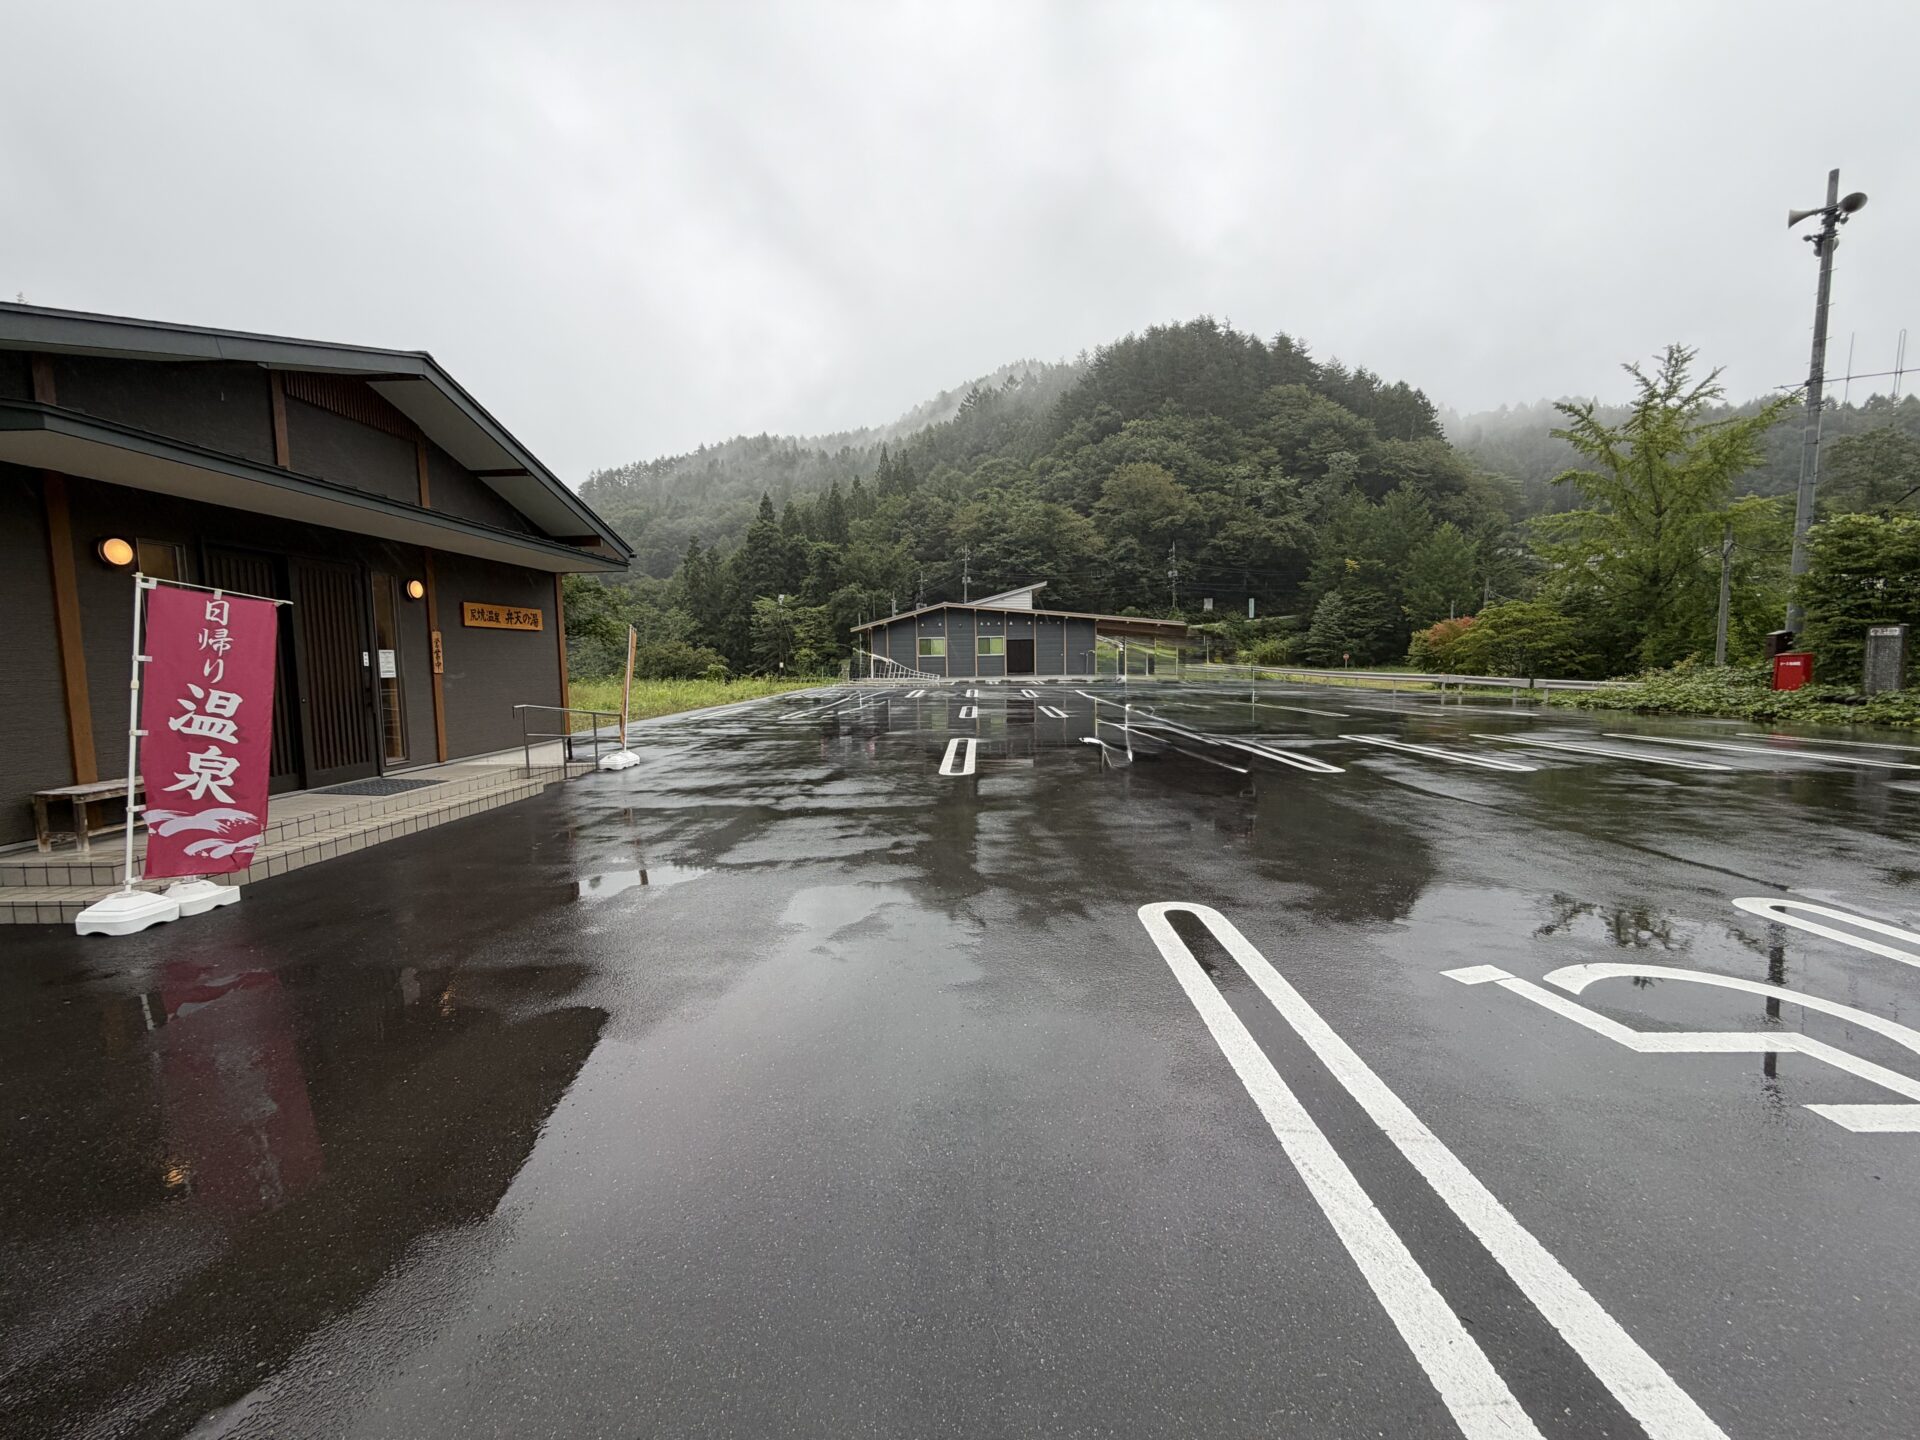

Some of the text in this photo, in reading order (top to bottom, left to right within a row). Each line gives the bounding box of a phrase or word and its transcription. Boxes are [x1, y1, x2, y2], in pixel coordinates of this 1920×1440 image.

[505, 609, 539, 628] 弁天の湯
[162, 600, 244, 804] 日帰り温泉
